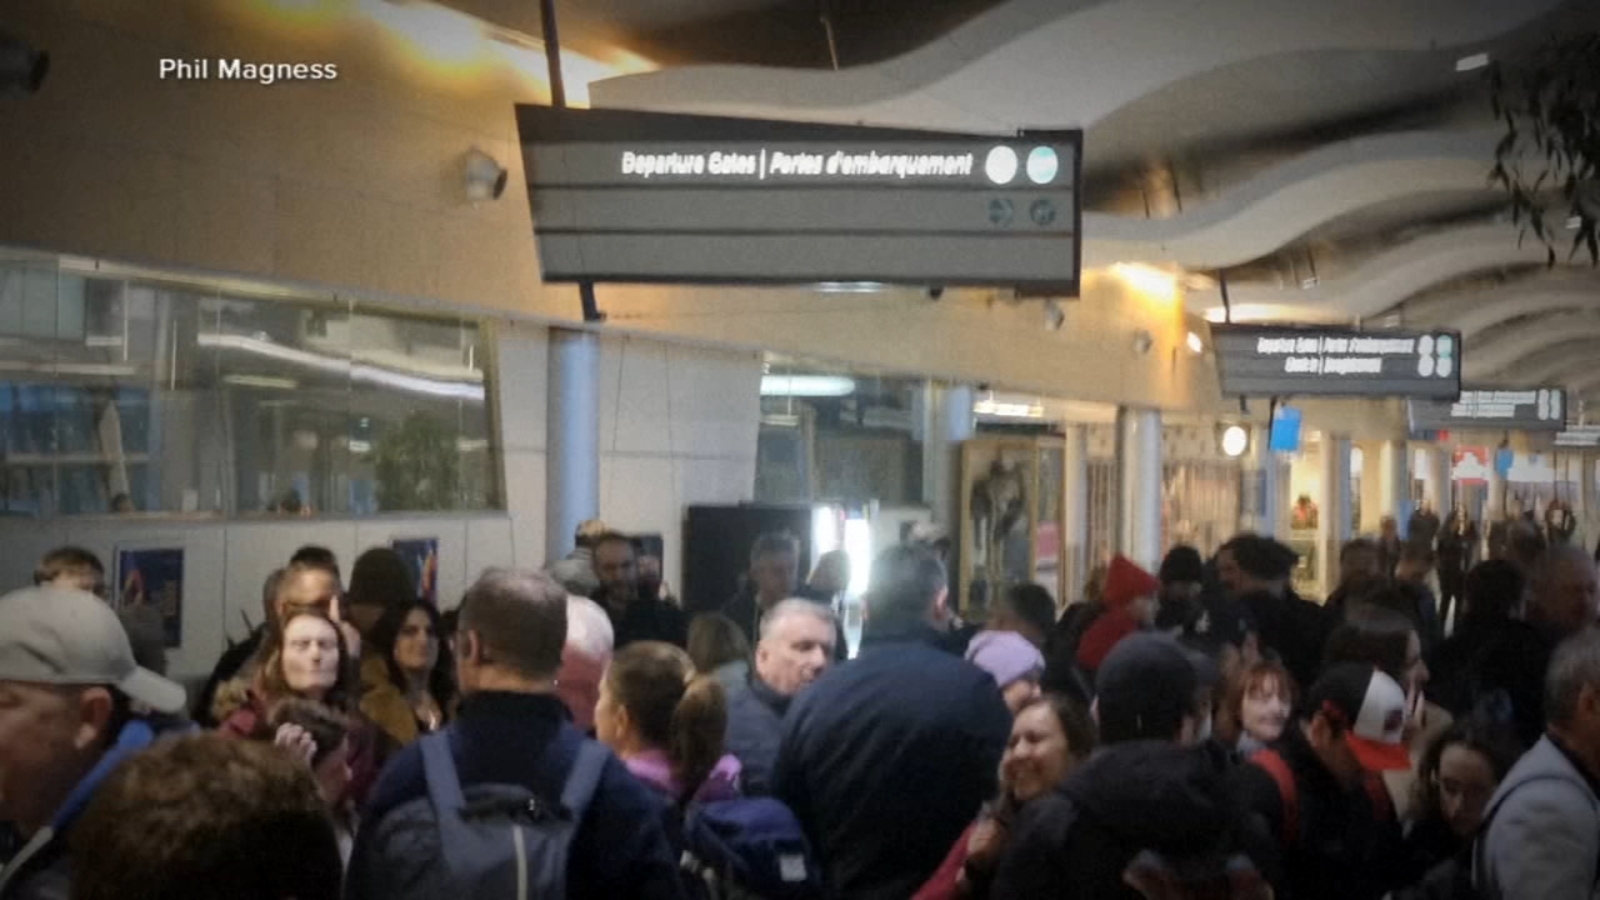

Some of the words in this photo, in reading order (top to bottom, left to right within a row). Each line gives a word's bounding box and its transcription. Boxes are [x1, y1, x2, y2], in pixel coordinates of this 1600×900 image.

[621, 151, 705, 178] Departure
[708, 151, 757, 175] Gates
[769, 151, 824, 175] Portes
[826, 150, 974, 179] d'embarquement
